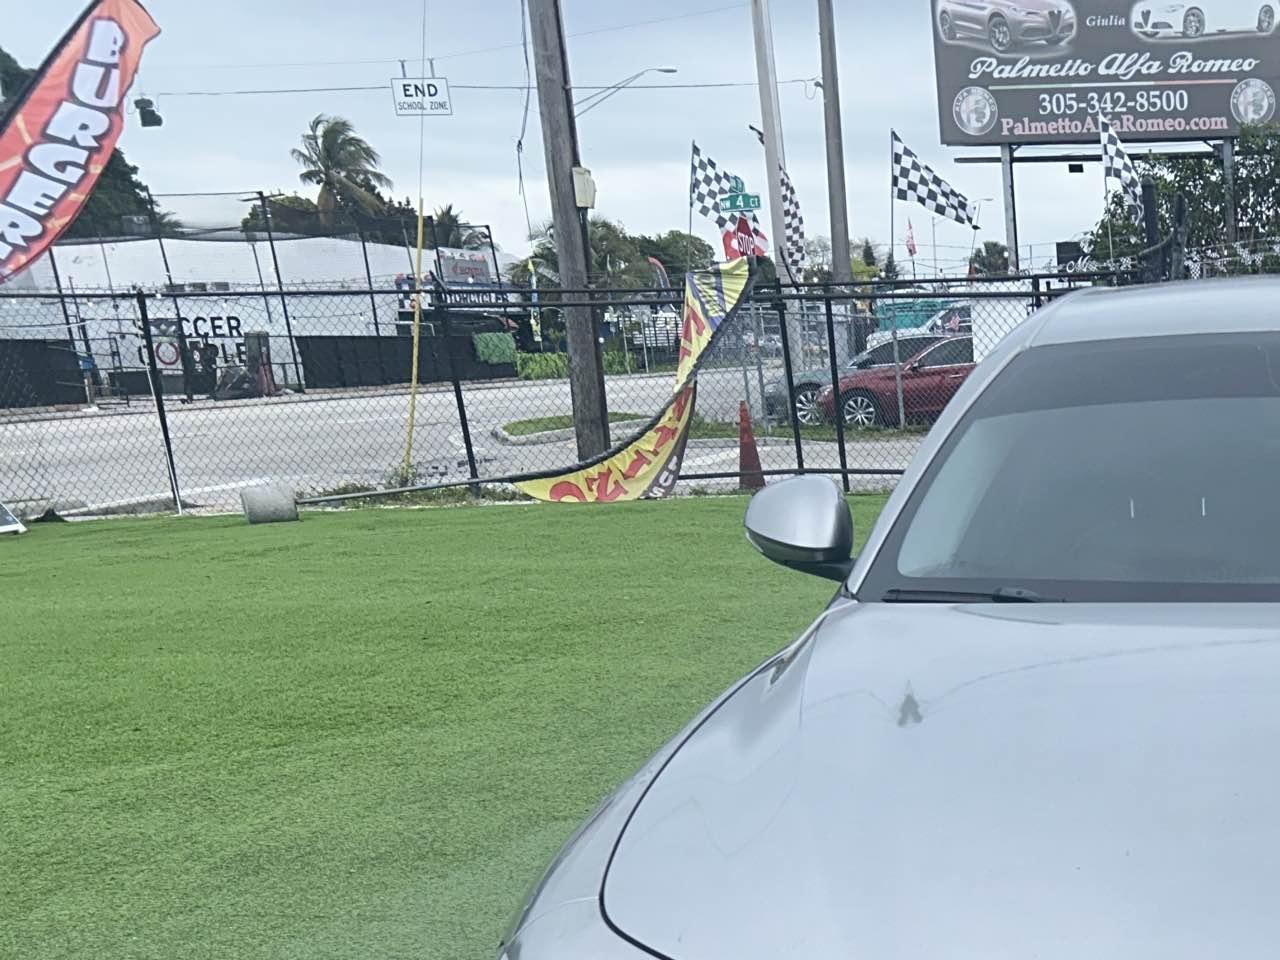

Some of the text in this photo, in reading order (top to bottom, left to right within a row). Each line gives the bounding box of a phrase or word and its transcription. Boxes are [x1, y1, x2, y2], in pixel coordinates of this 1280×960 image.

[1085, 14, 1126, 28] Giulia
[968, 51, 1261, 80] Palmetto Alfa Romeo
[402, 83, 438, 98] END
[398, 101, 449, 111] SCHOOL ZONE
[1038, 90, 1189, 115] 305-342-8500
[0, 19, 127, 260] BURGER
[736, 195, 744, 208] 4
[750, 197, 759, 207] CT
[737, 232, 755, 256] STOP
